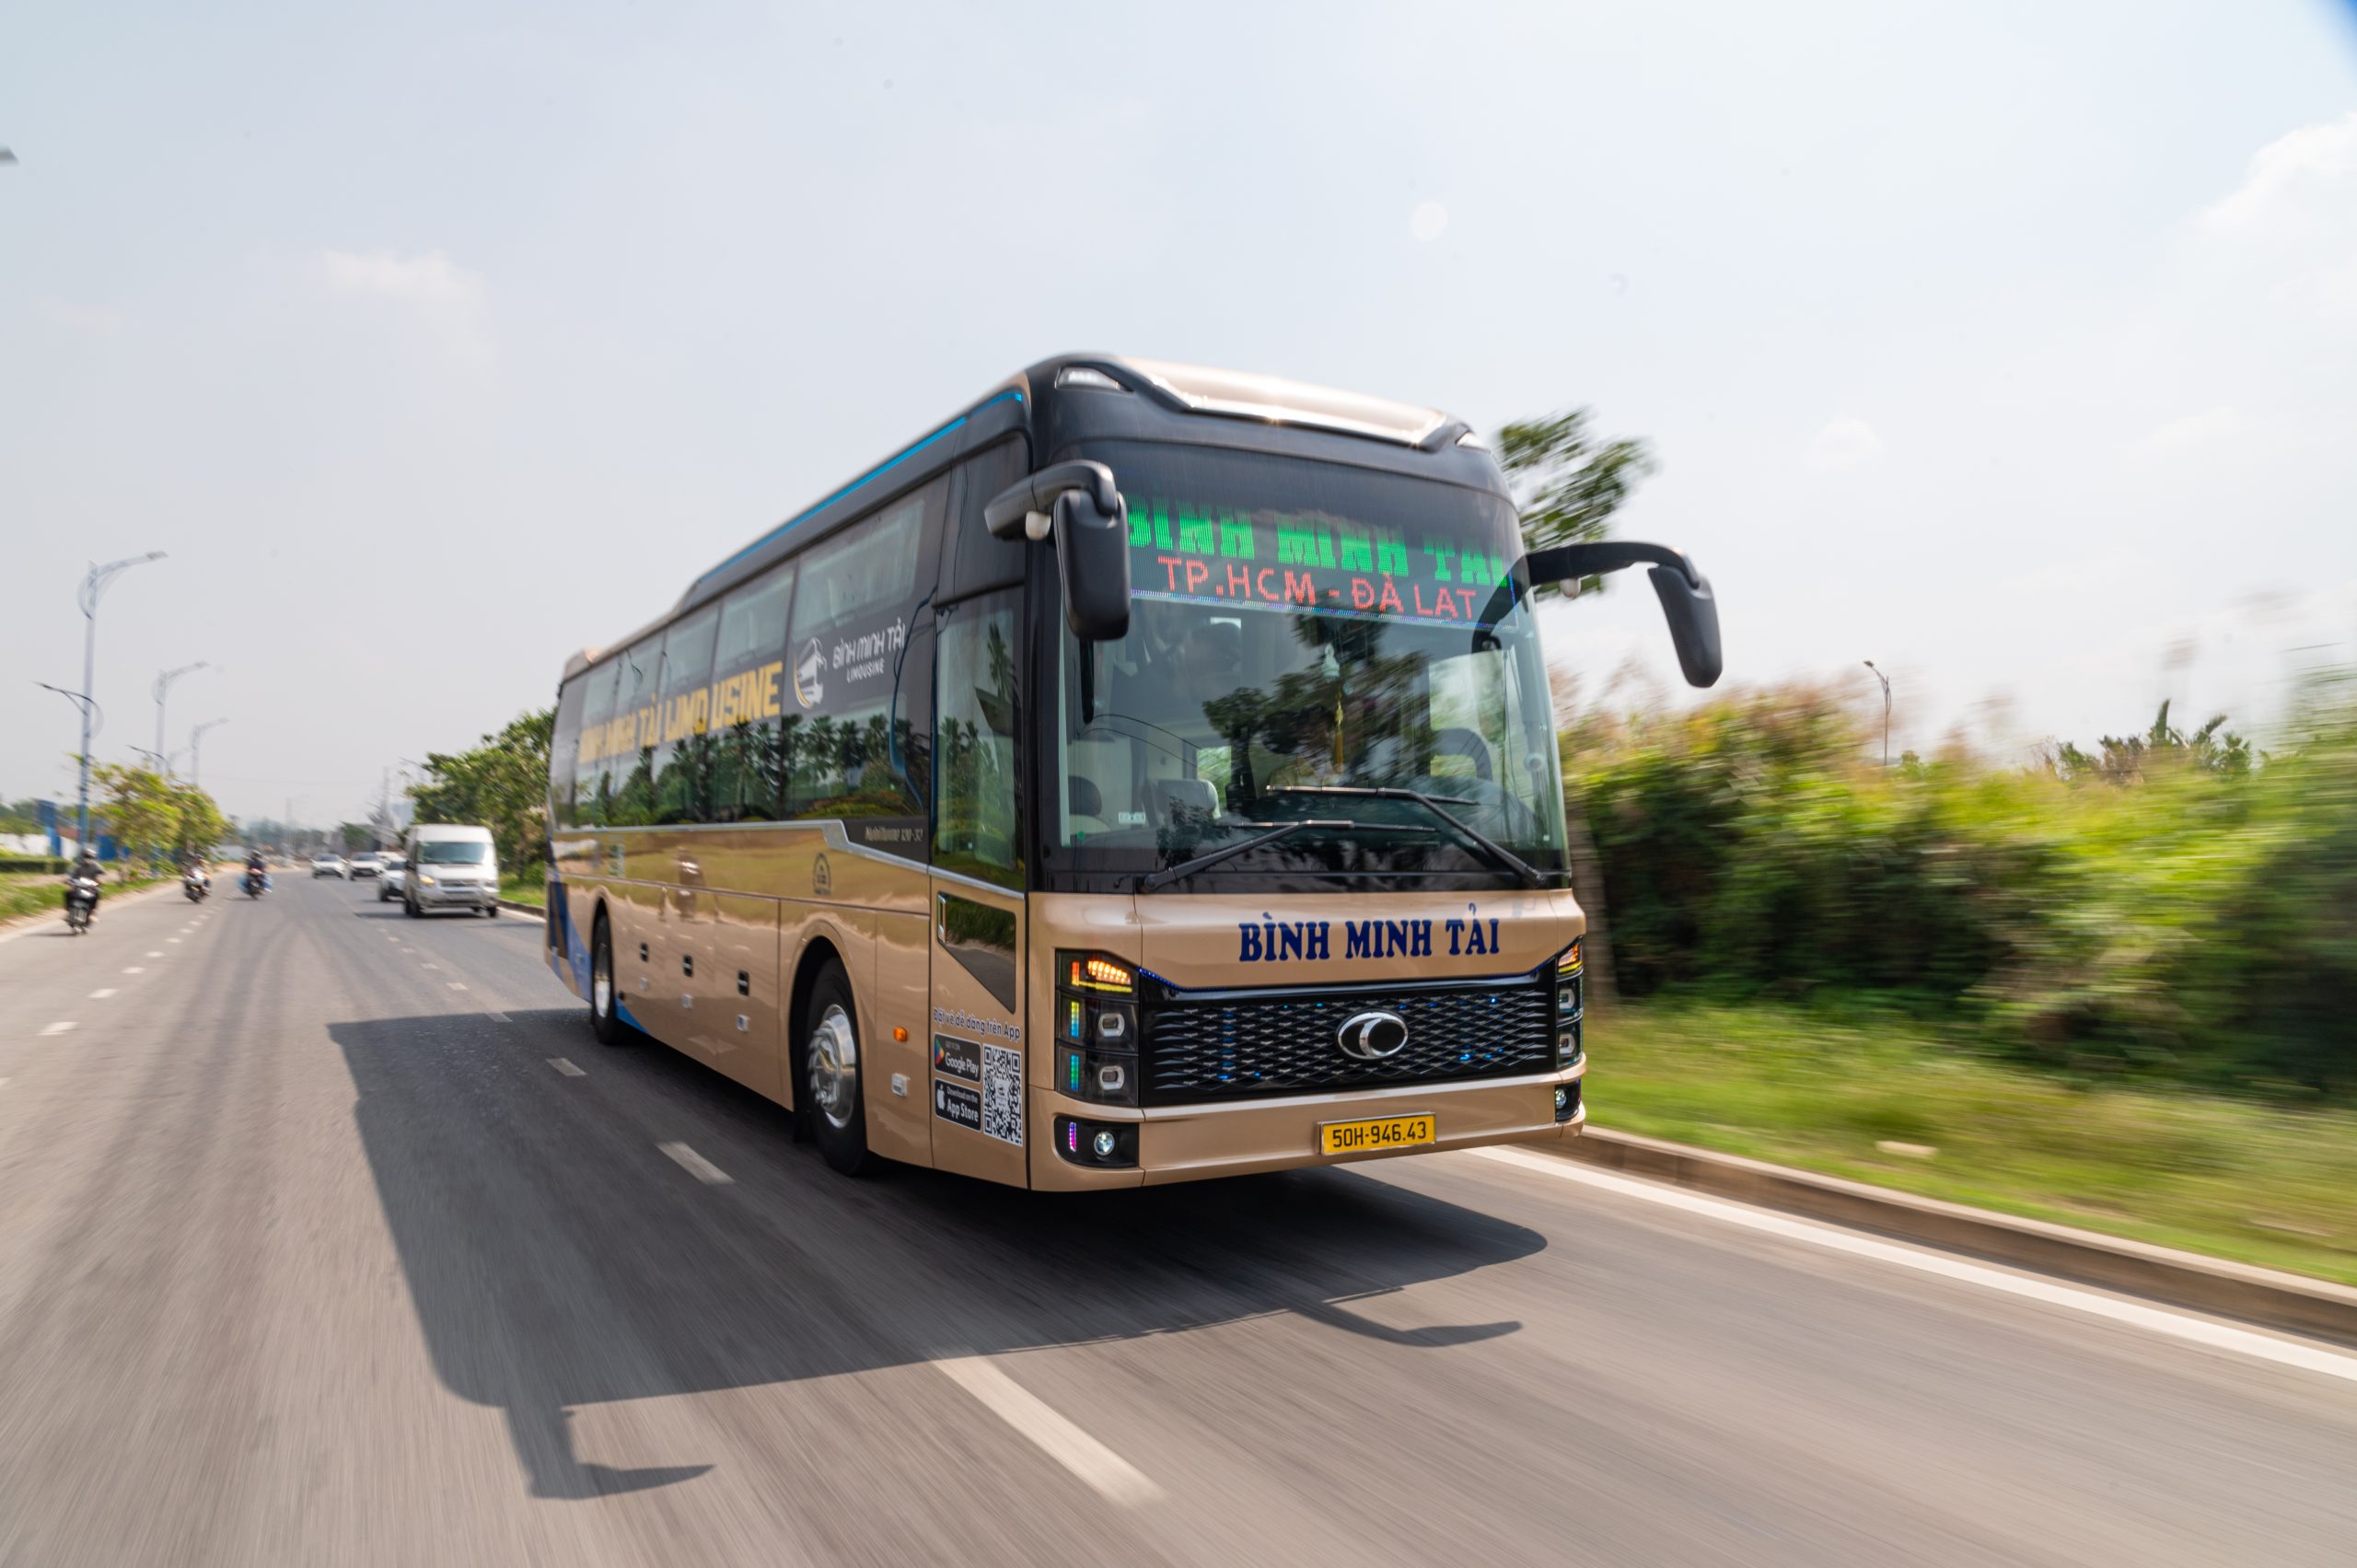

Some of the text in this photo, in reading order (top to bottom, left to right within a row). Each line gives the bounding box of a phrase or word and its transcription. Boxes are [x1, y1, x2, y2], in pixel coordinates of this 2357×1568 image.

[1157, 555, 1317, 606] TP.HCM
[847, 657, 885, 683] LIMOUSINE
[1238, 902, 1500, 962] BÌNH MINH TẢI
[1004, 1023, 1021, 1042] App
[945, 1051, 979, 1077] Google Play
[946, 1098, 979, 1122] App Store
[1332, 1121, 1427, 1148] 50H-946.43
